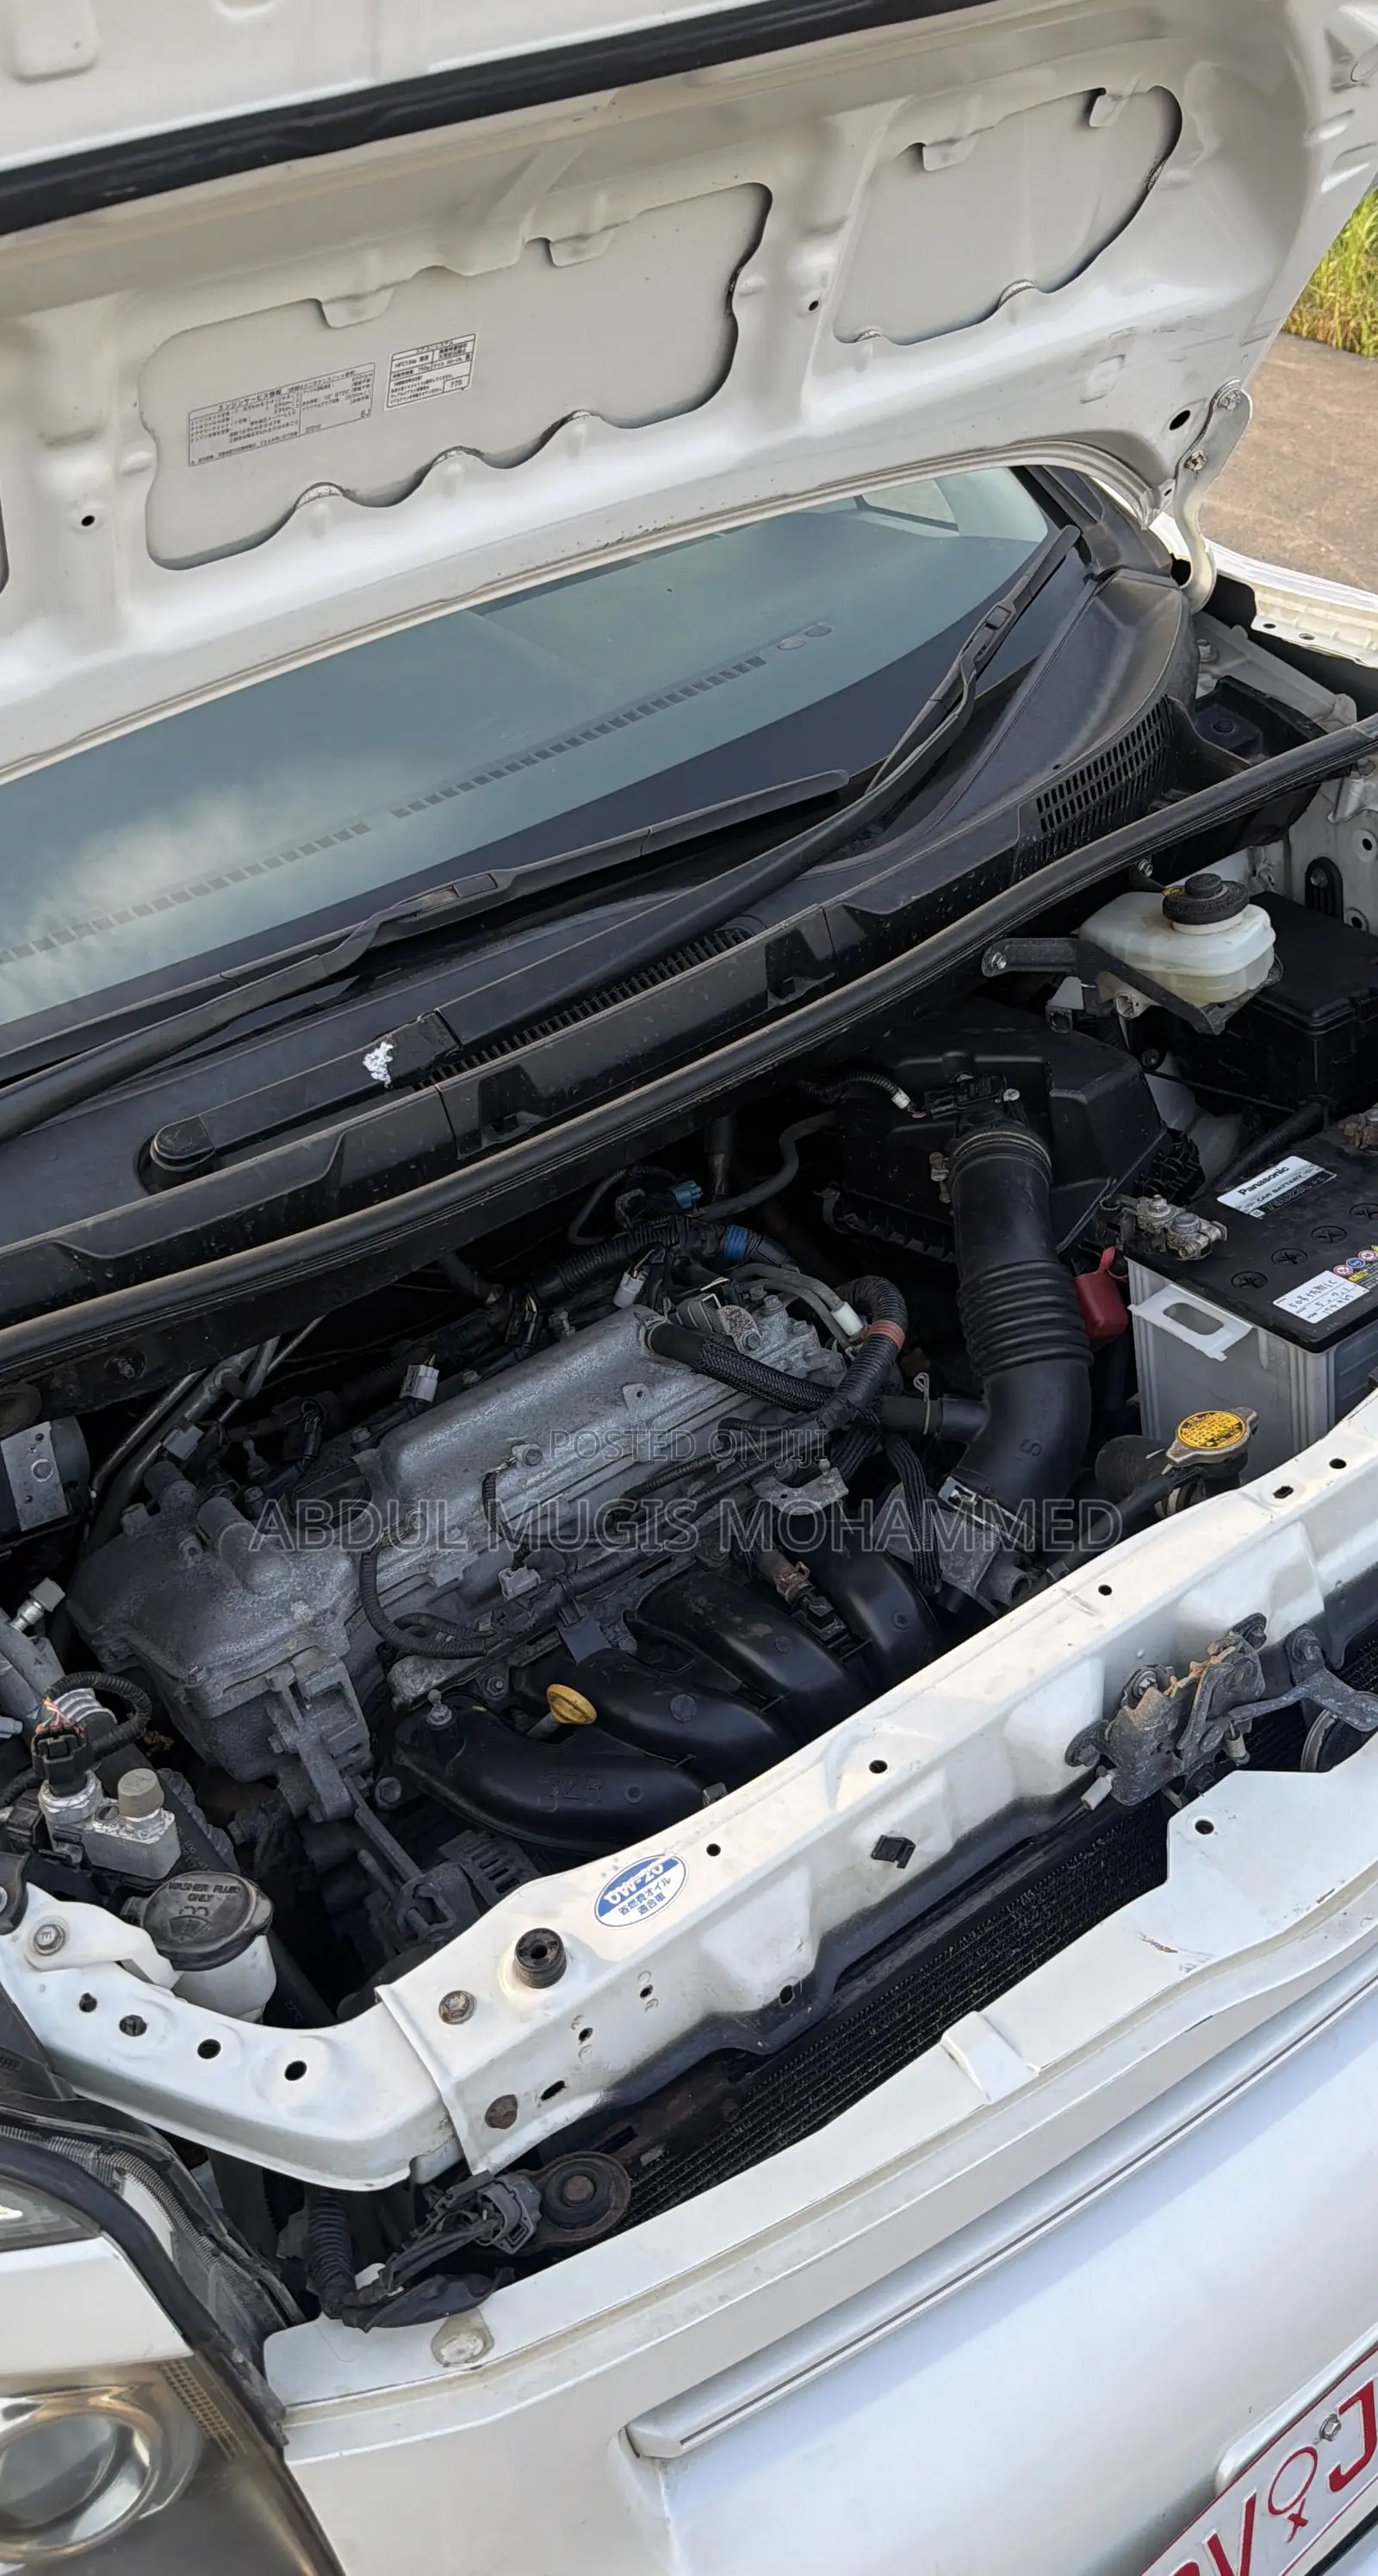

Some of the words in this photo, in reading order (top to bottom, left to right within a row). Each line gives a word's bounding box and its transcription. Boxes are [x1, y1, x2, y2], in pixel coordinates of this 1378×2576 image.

[1237, 1165, 1291, 1195] Panasonic
[1257, 1192, 1274, 1202] CAR
[1272, 1174, 1303, 1194] BATTERY
[169, 1882, 209, 1893] WASHER
[213, 1884, 241, 1894] FLUID
[188, 1892, 214, 1903] ONLY
